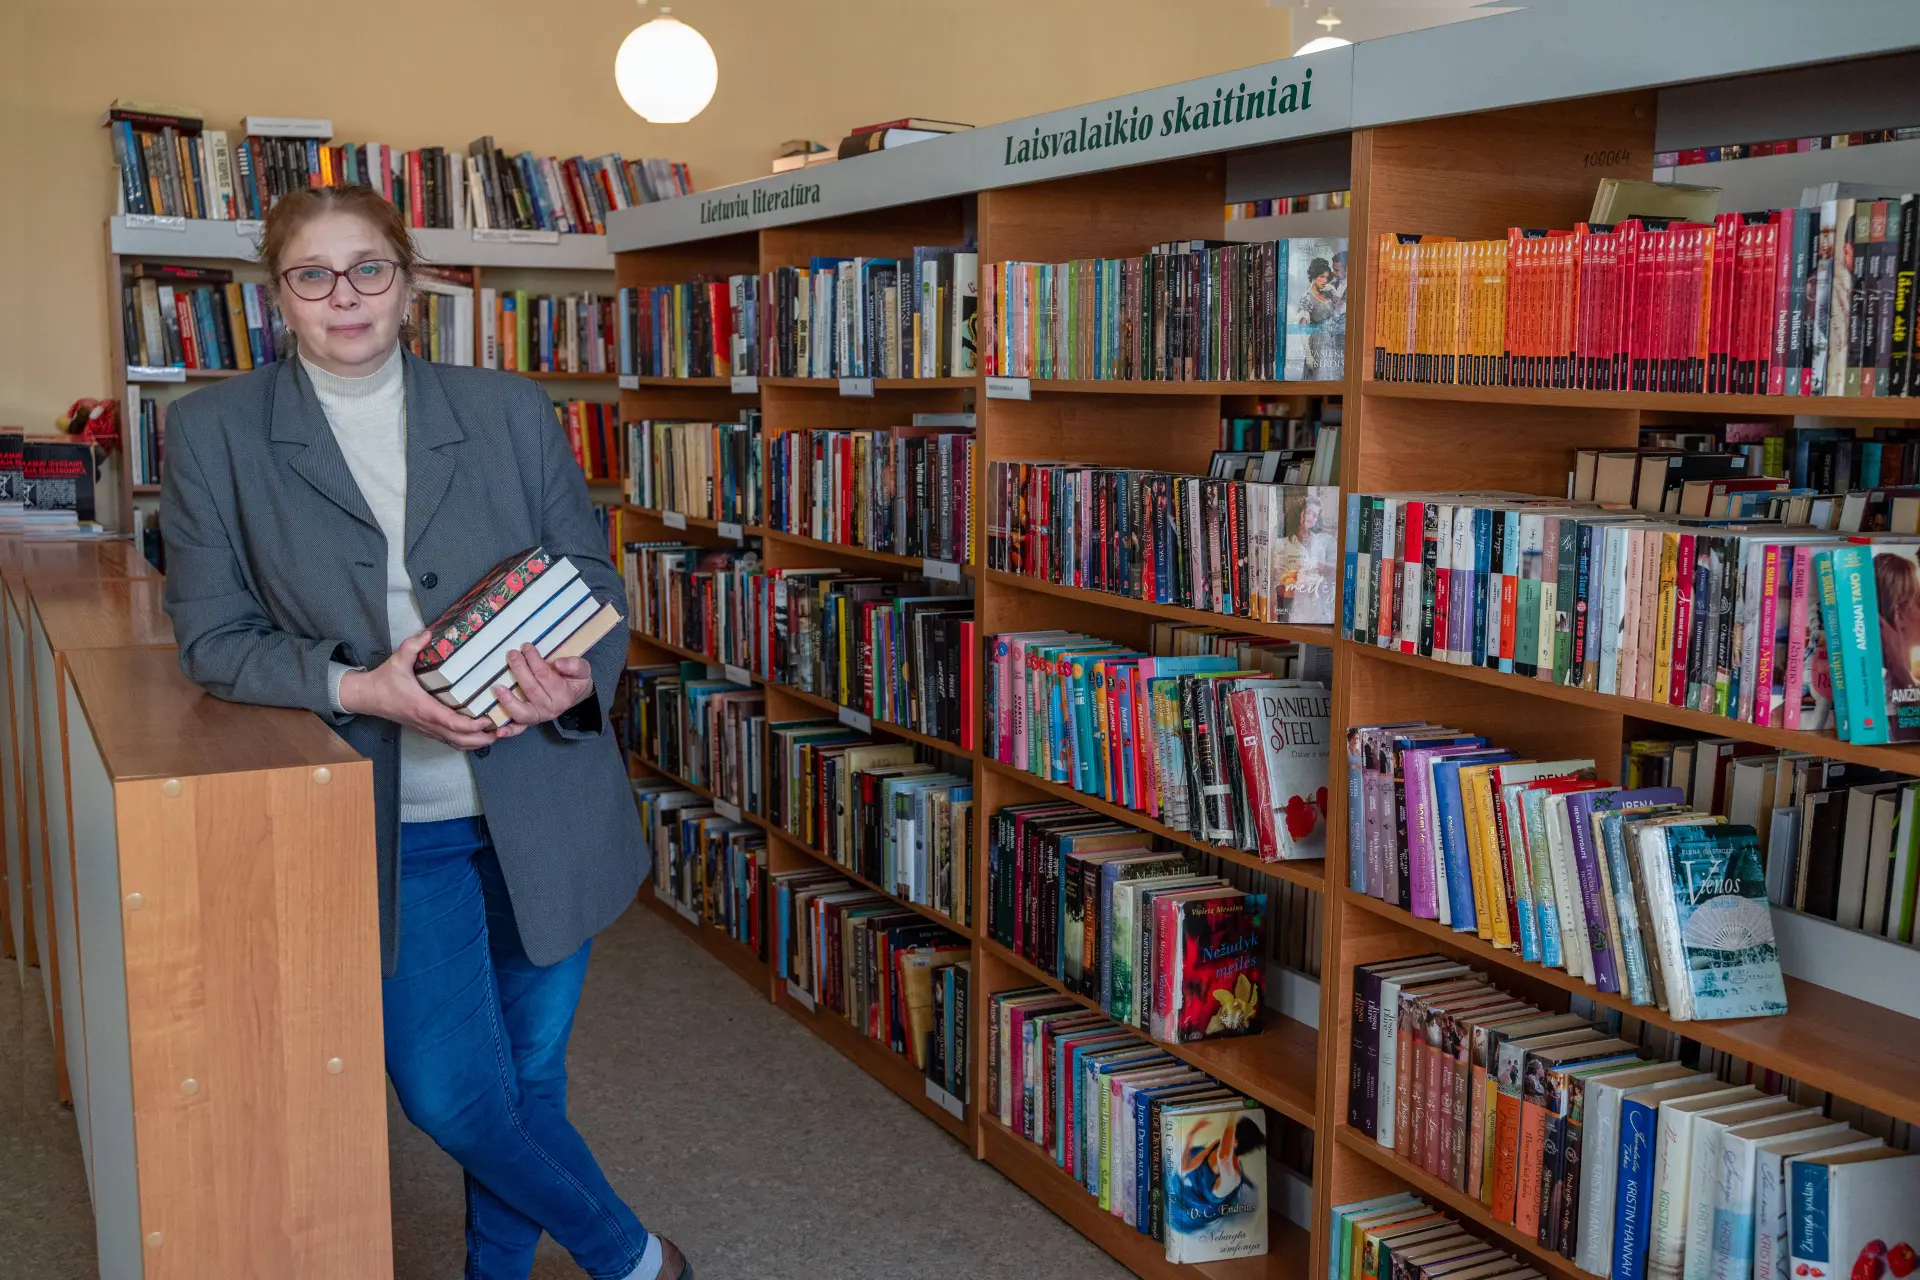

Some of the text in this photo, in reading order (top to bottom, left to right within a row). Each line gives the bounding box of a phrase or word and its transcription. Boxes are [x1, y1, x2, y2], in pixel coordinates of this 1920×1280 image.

[1004, 68, 1313, 166] Laisvalaikio skaitiniai
[1583, 149, 1629, 168] 100064
[700, 181, 821, 224] Lietuvių literatūra
[1766, 552, 1776, 566] JILL
[1796, 554, 1807, 568] JILL
[1765, 566, 1775, 596] SHALVIS
[1795, 569, 1807, 598] SHALVIS
[1849, 573, 1862, 604] TAVO
[1853, 605, 1867, 650] AMŽINAI
[1196, 686, 1206, 722] PERMAINOS
[1263, 696, 1330, 718] DANIELLE
[1271, 718, 1319, 754] STEEL
[1576, 825, 1586, 860] BUIVYDAITĖ
[1136, 866, 1189, 879] Melissa Hill
[1586, 863, 1599, 917] Trečias kartas
[1192, 904, 1244, 917] Violeta Messina
[1202, 932, 1259, 963] Nežudyk
[1216, 955, 1256, 978] meilės
[955, 989, 964, 1026] ŽVĖRYS
[955, 1038, 963, 1076] ŽMONĖS
[1136, 1103, 1145, 1127] JUDE
[1101, 1110, 1109, 1160] Deveraux
[1152, 1106, 1160, 1181] JUDE DEVERAUX
[1504, 1103, 1516, 1201] JULIE GARWOOD
[1137, 1129, 1145, 1179] DEVERAUX
[1203, 1205, 1216, 1218] C.
[1218, 1202, 1256, 1215] Endrius
[1656, 1189, 1670, 1233] KRISTIN
[1802, 1182, 1814, 1253] Žiemos sodas
[1199, 1229, 1246, 1243] Nebaigta
[1620, 1179, 1639, 1277] KRISTIN HANNAH
[1220, 1242, 1261, 1257] simfonija
